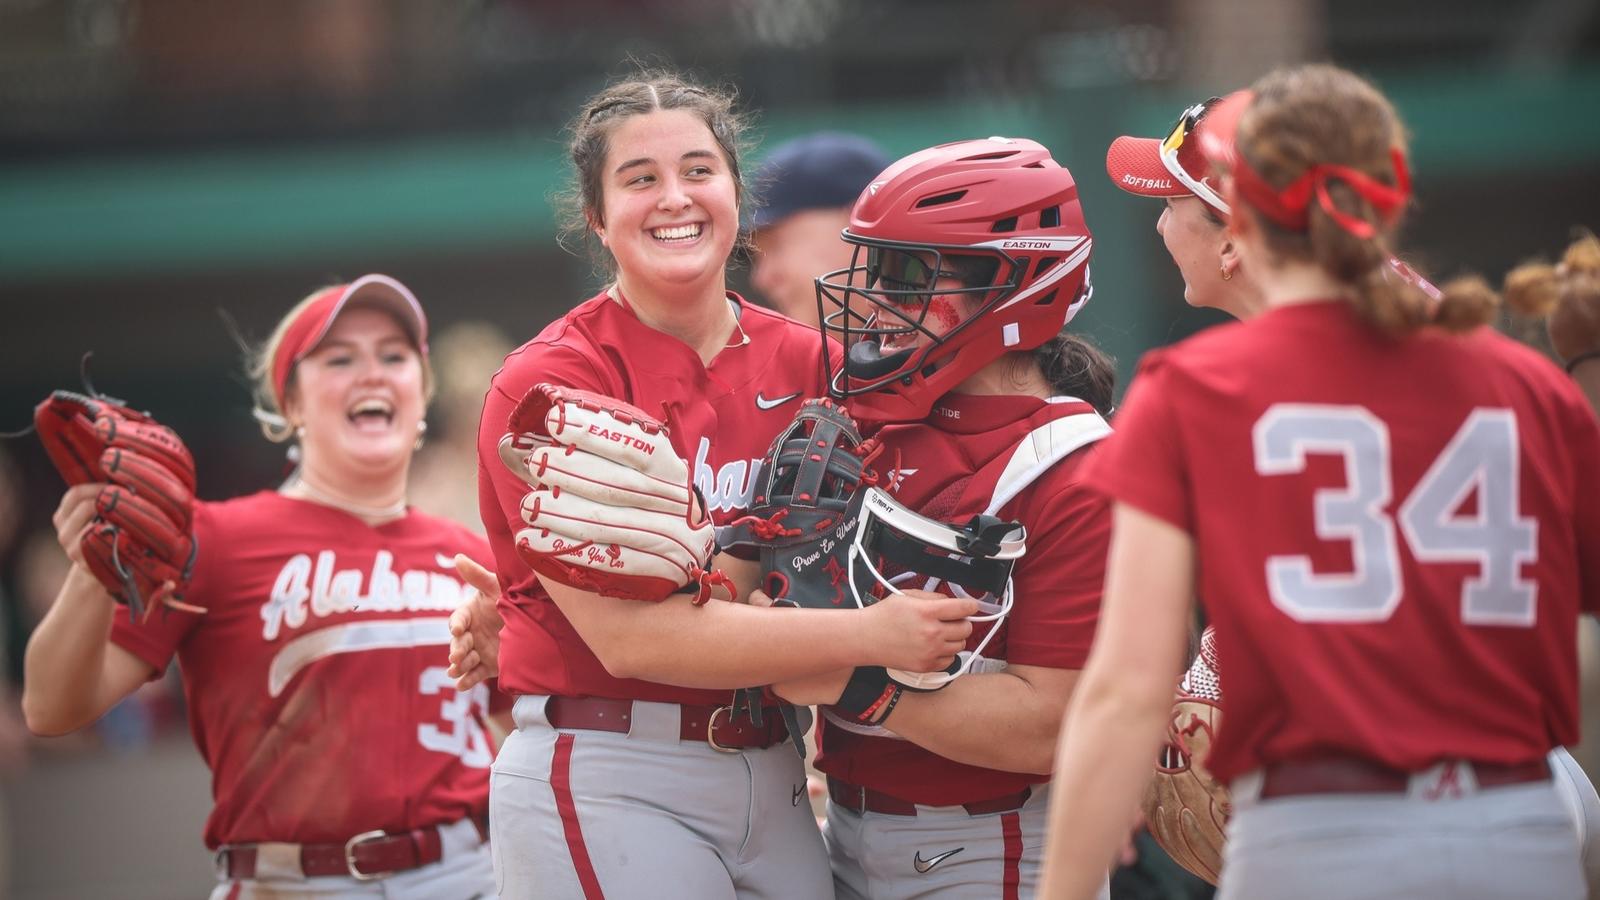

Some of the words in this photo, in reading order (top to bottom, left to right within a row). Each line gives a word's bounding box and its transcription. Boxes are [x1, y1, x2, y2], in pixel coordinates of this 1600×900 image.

[1122, 174, 1172, 189] SOFTBALL
[1002, 241, 1052, 249] EASTON
[588, 424, 656, 456] EASTON
[1253, 403, 1540, 627] 34
[587, 546, 606, 565] You
[792, 556, 820, 572] Prove
[259, 549, 478, 641] Alabam
